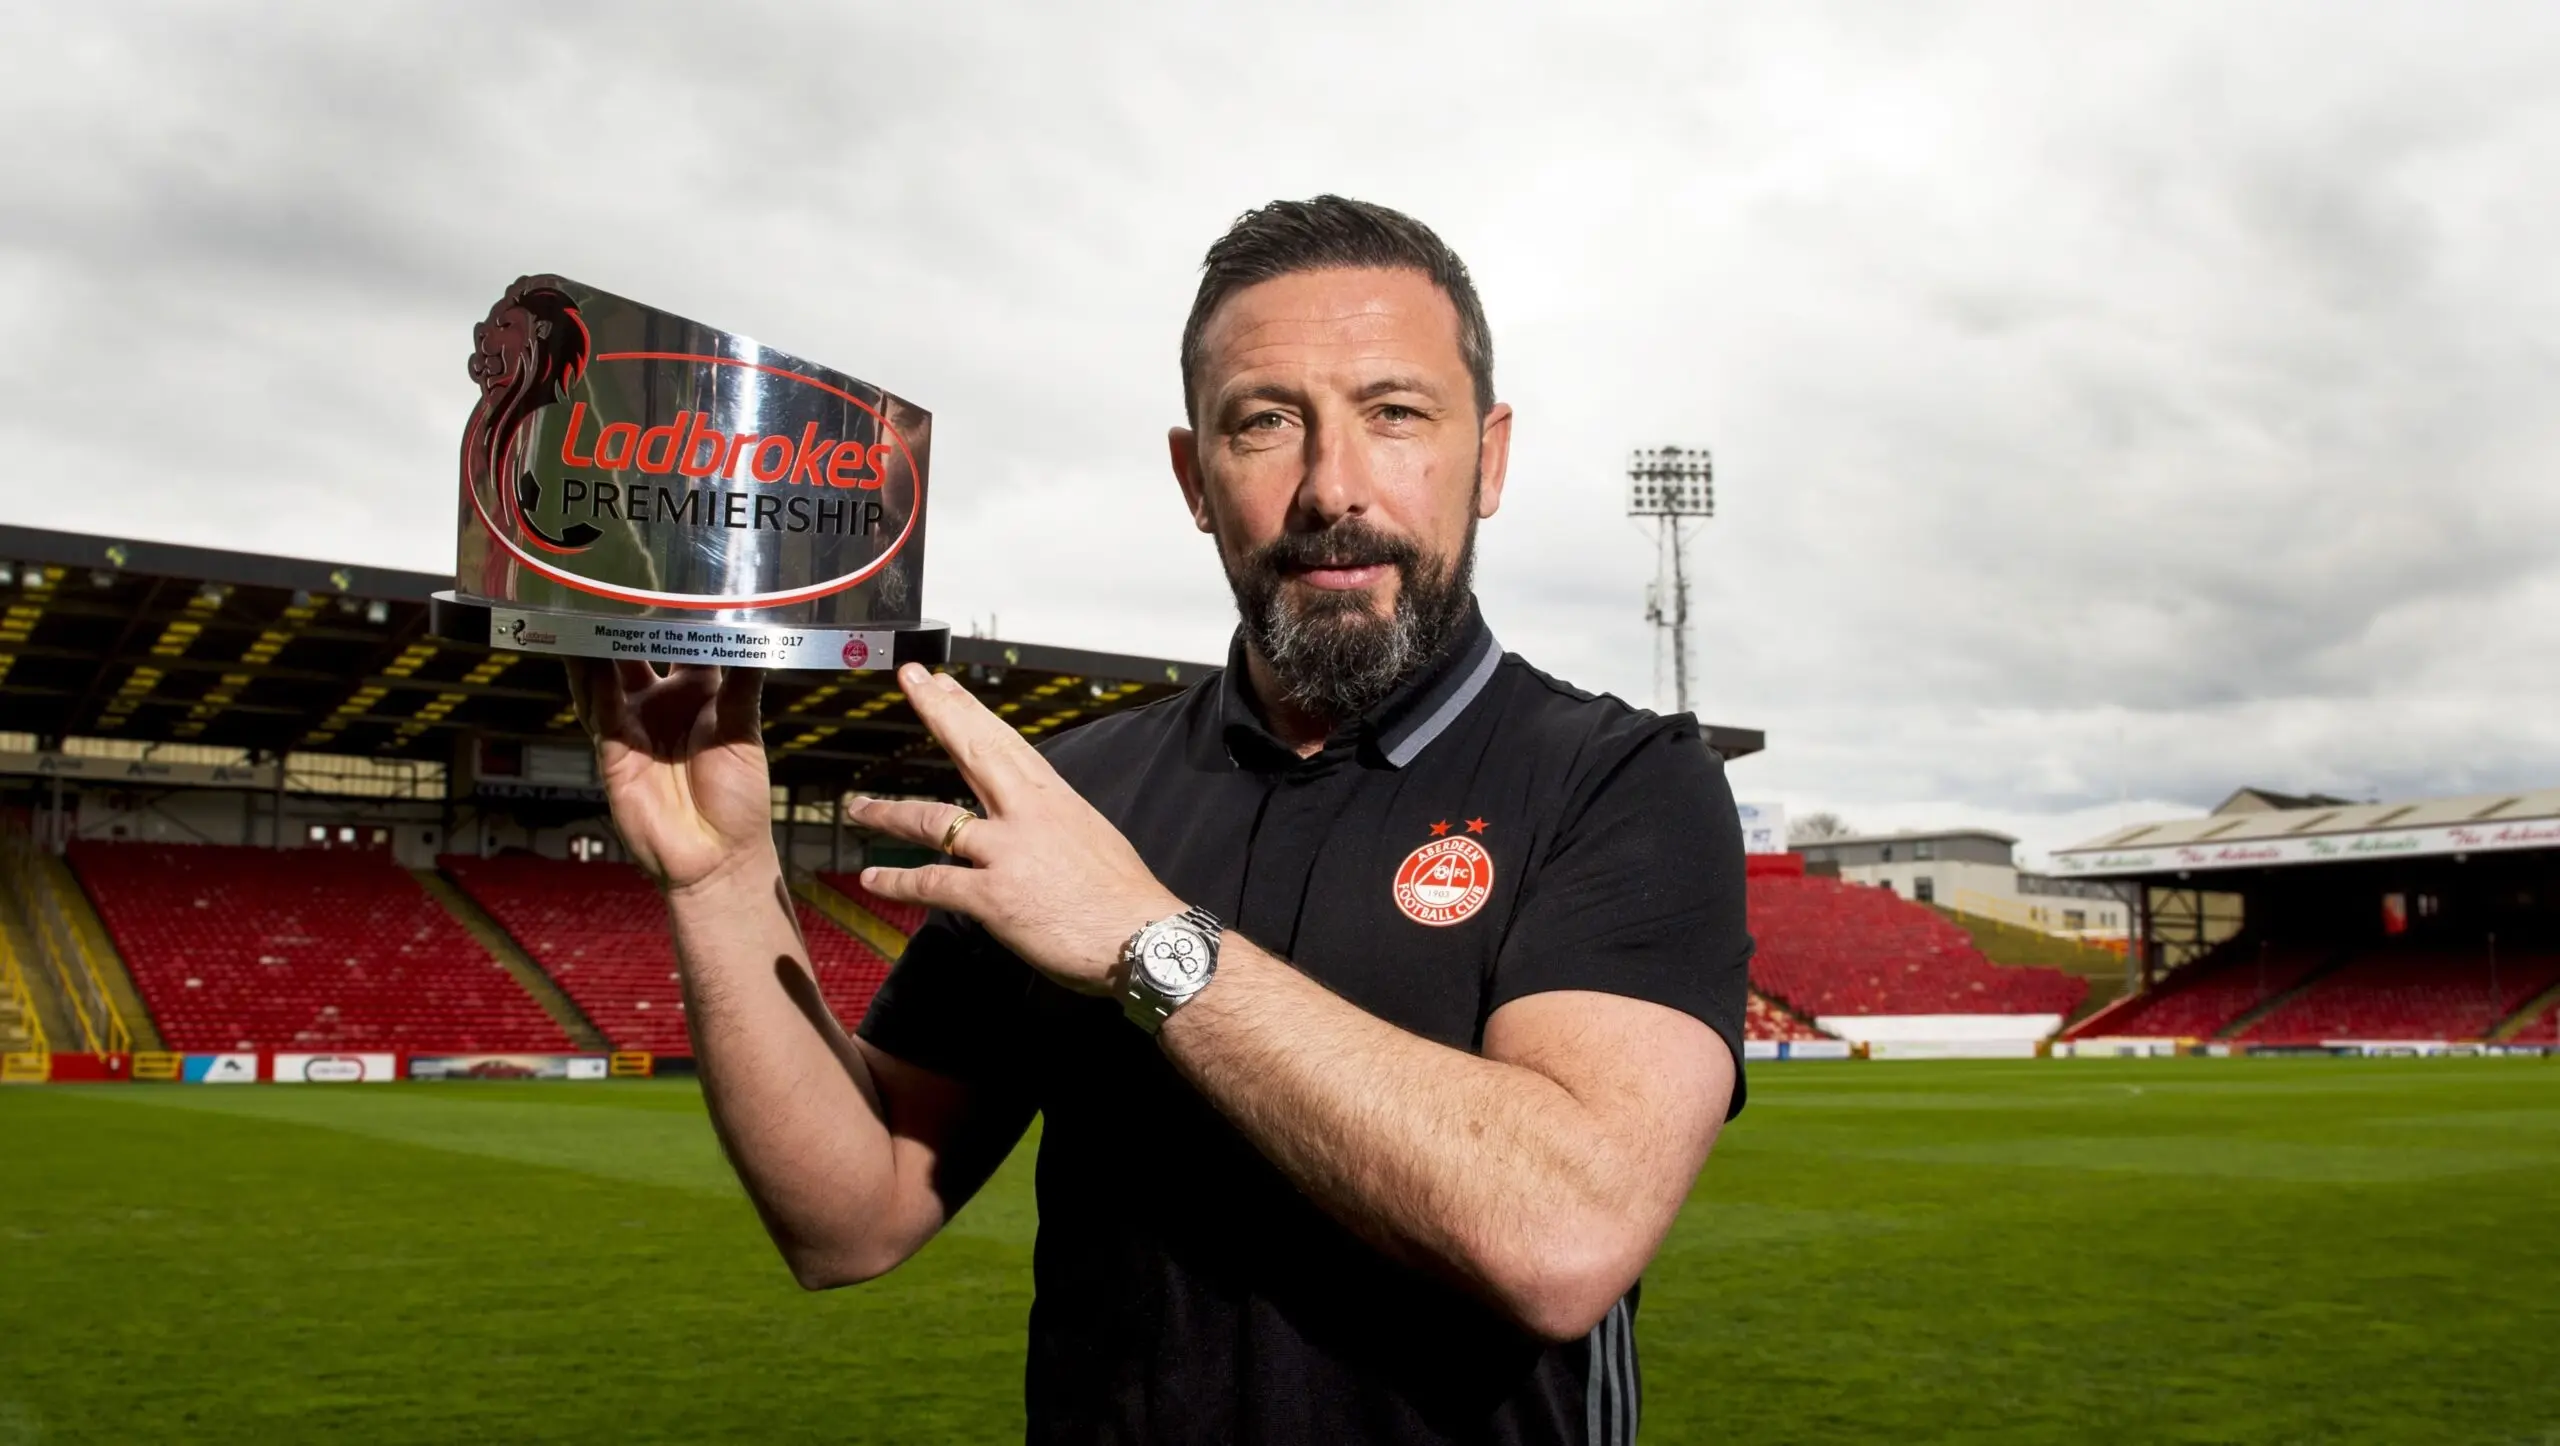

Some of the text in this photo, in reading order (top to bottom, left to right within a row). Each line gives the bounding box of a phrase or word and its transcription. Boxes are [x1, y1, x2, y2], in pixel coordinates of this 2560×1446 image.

[561, 402, 892, 490] Ladbrokes
[561, 478, 884, 536] PREMIERSHIP
[595, 625, 645, 640] Manager
[648, 629, 662, 640] of
[665, 630, 684, 641] the
[687, 631, 724, 644] Month
[735, 633, 771, 646] March
[612, 641, 647, 653] Derek
[650, 643, 700, 656] McInnes
[711, 646, 767, 659] Aberdeen
[1417, 840, 1482, 863] ABERDEEN
[1453, 867, 1470, 879] FC
[1398, 882, 1485, 921] FOOTBALL CLUB
[1427, 889, 1451, 899] 1903
